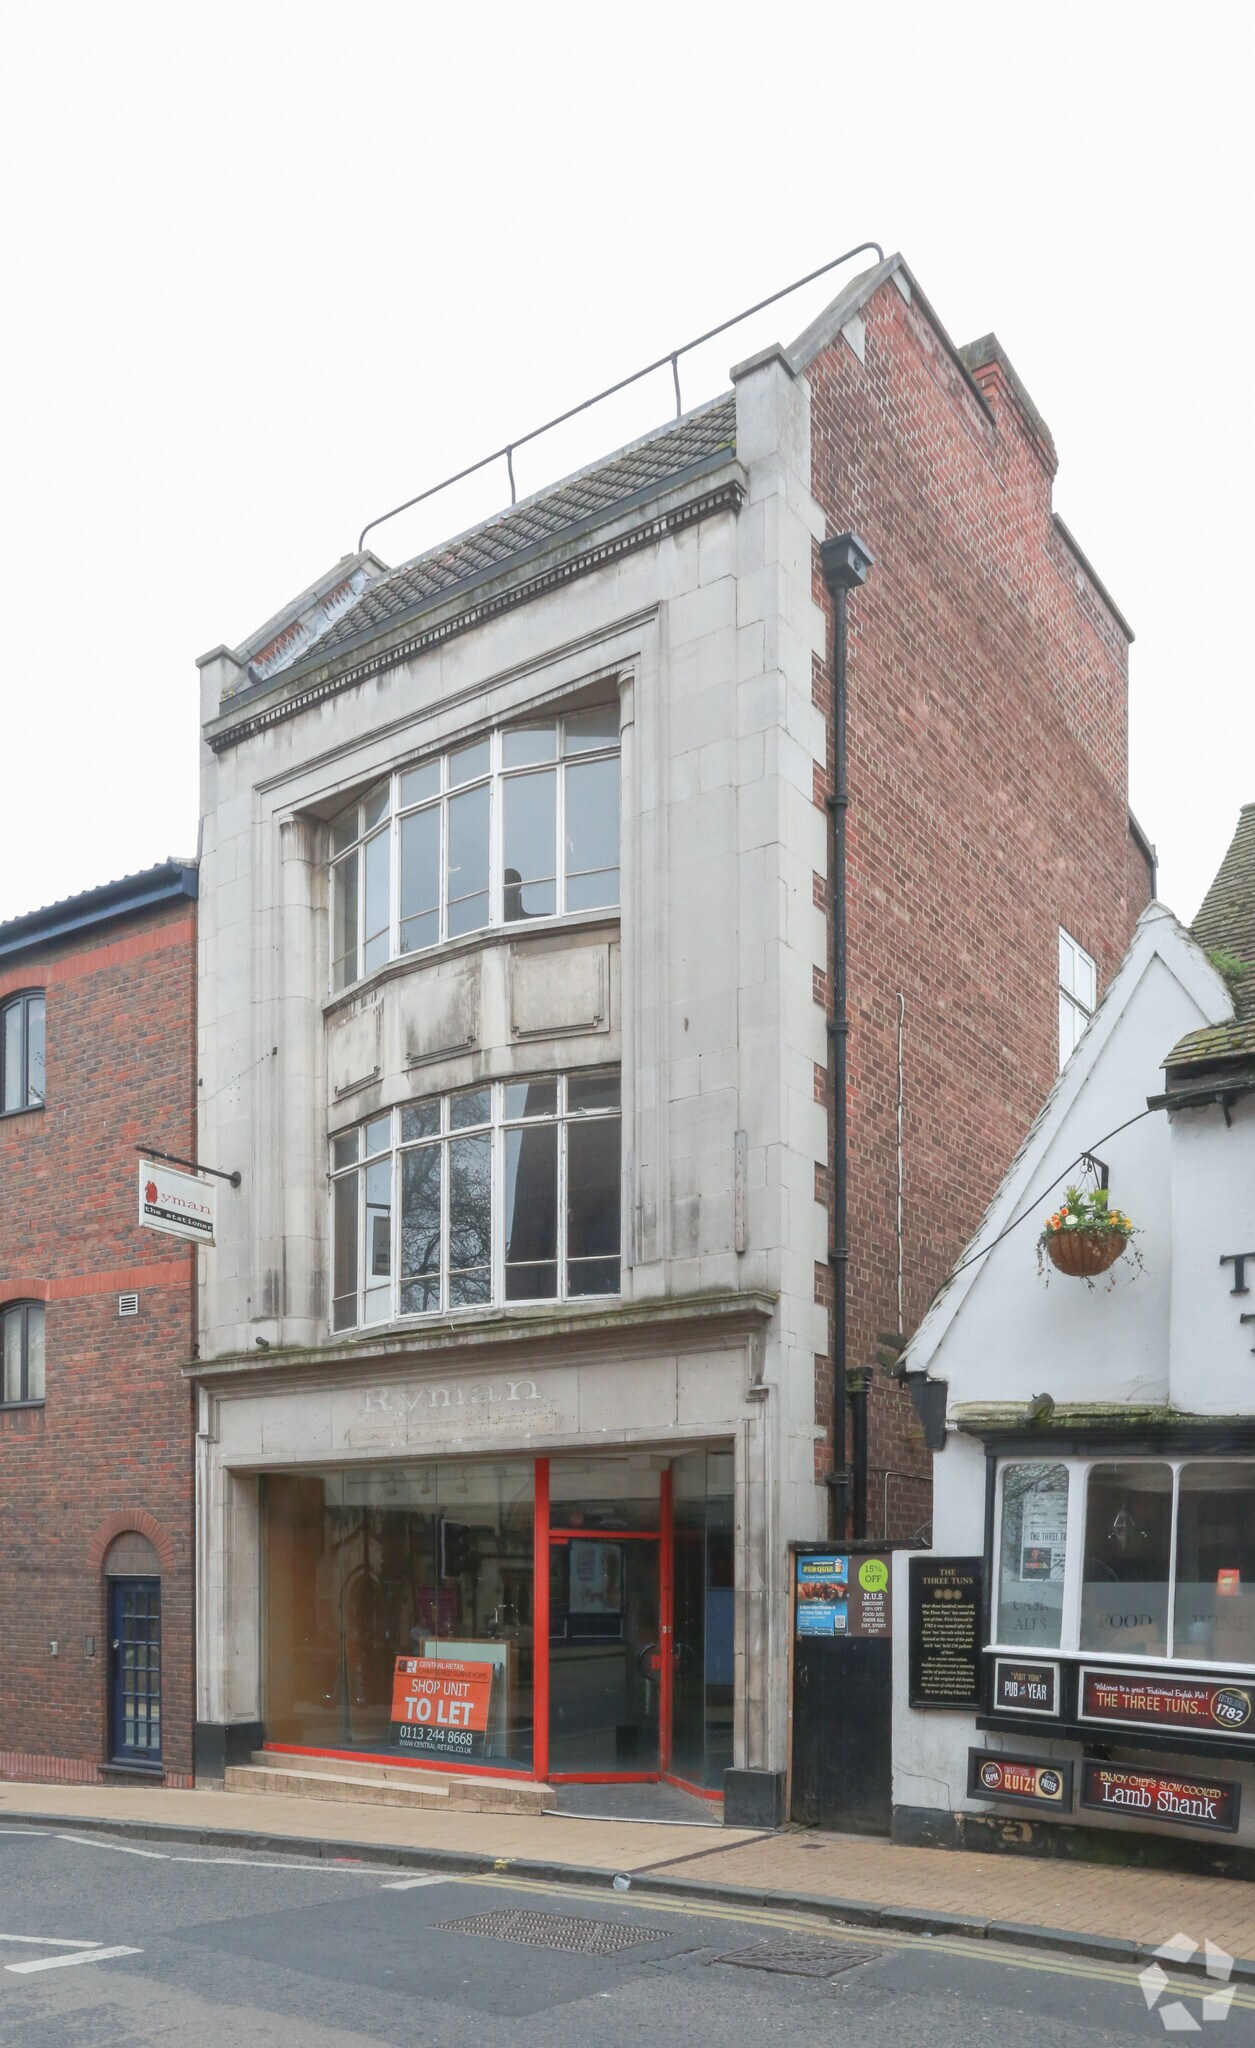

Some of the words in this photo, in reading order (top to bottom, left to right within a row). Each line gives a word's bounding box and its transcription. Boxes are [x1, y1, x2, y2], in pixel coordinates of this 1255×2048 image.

[145, 1206, 161, 1215] the
[166, 1213, 212, 1230] stationer
[362, 1379, 542, 1416] Ryman
[1042, 1532, 1058, 1541] THREE
[866, 1565, 882, 1573] 15%
[939, 1568, 956, 1576] THE
[864, 1575, 882, 1583] OFF
[922, 1577, 950, 1585] THREE
[950, 1577, 974, 1585] TUNS
[446, 1662, 464, 1670] RETAIL
[411, 1679, 440, 1694] SHOP
[443, 1682, 470, 1696] UNIT
[1004, 1681, 1018, 1697] PUB
[1028, 1683, 1047, 1700] YEAR
[405, 1696, 432, 1721] TO
[437, 1700, 474, 1726] LET
[1096, 1692, 1118, 1708] THE
[1122, 1694, 1160, 1711] THREE
[1164, 1698, 1208, 1716] TUNS...
[1216, 1703, 1244, 1722] 1782
[400, 1726, 424, 1740] 0113
[426, 1728, 445, 1742] 244
[448, 1731, 472, 1746] 8668
[1004, 1774, 1035, 1792] QUIZ!
[1100, 1772, 1128, 1784] ENJOY
[1159, 1781, 1182, 1793] SLOW
[1183, 1784, 1222, 1798] COOKED
[1103, 1782, 1152, 1808] Lamb
[1157, 1791, 1216, 1820] Shank
